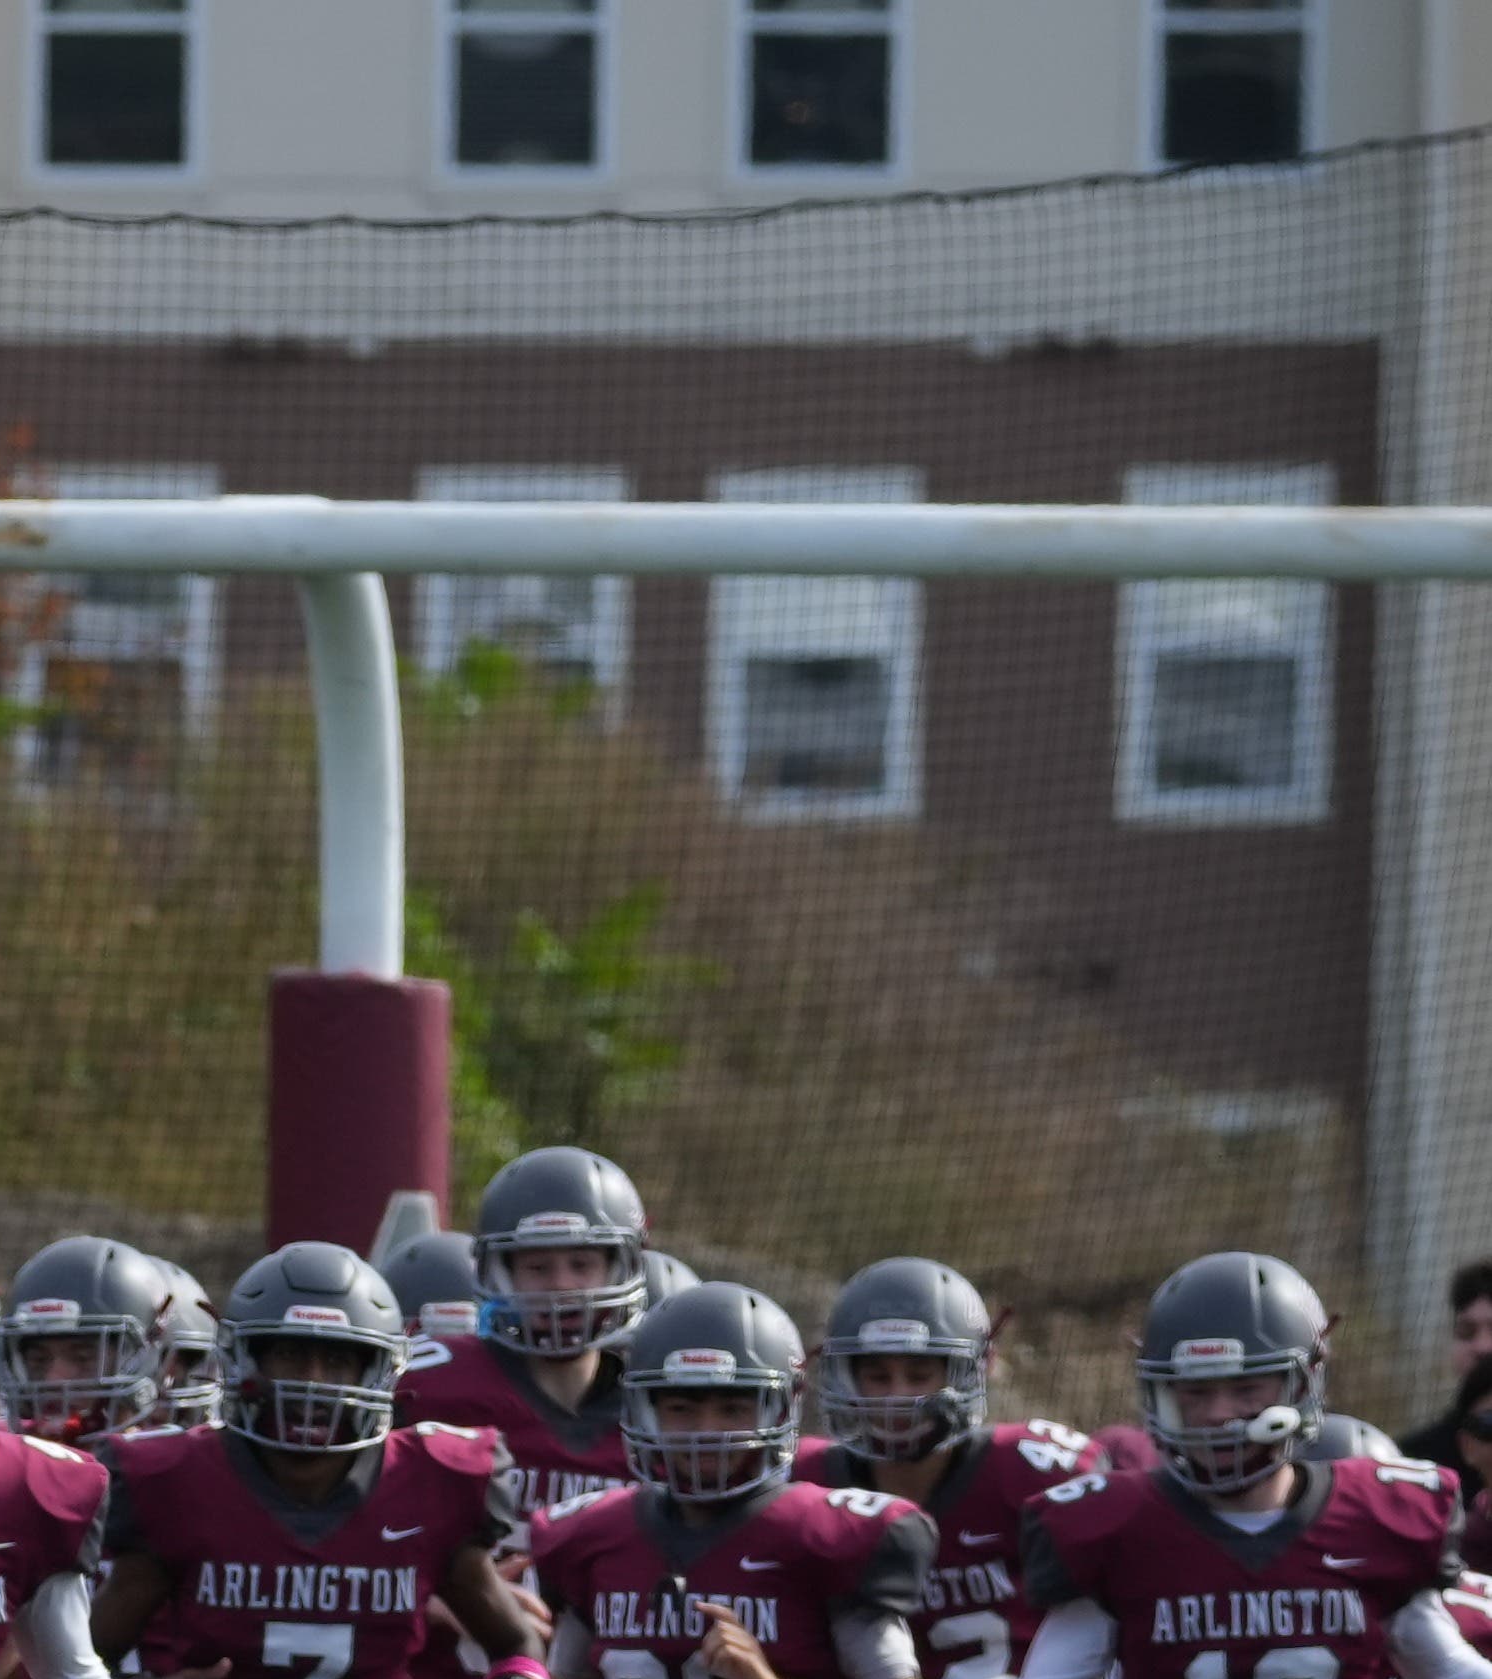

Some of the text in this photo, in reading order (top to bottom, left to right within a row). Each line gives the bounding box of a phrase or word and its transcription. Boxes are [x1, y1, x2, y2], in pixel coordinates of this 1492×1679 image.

[826, 1487, 895, 1518] 2
[195, 1561, 417, 1614] ARLINGTON
[1150, 1588, 1366, 1644] ARLINGTON
